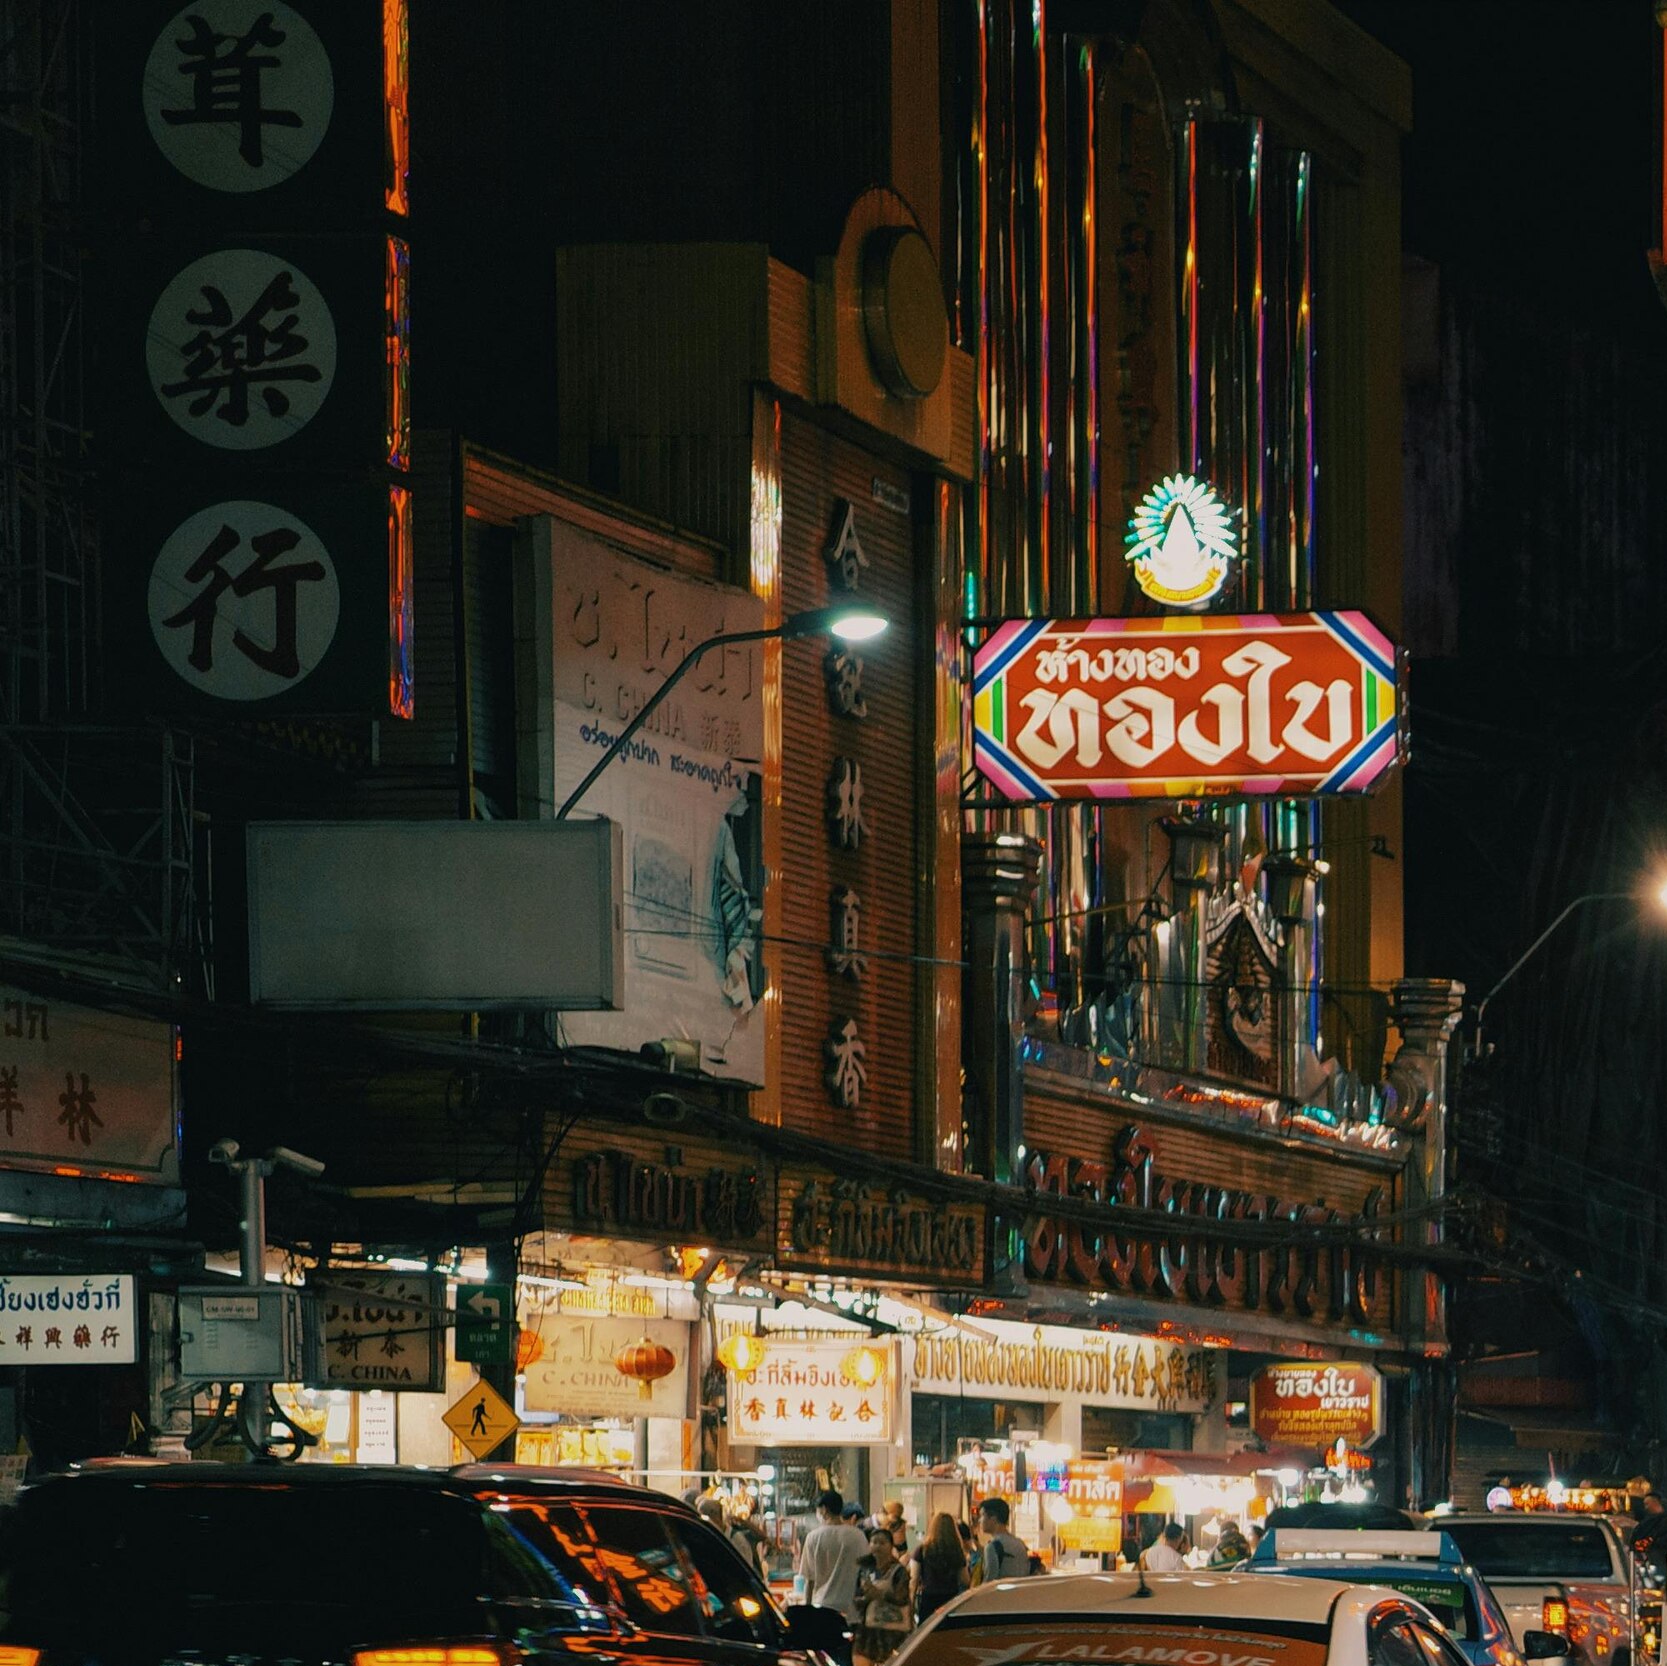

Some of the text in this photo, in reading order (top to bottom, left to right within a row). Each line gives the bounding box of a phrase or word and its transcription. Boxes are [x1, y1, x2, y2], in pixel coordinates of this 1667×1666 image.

[1036, 636, 1201, 681] ห้างทอง
[1015, 641, 1354, 769] ทองใบ
[352, 1364, 412, 1381] CHINA
[1275, 1366, 1356, 1399] ทองใบ
